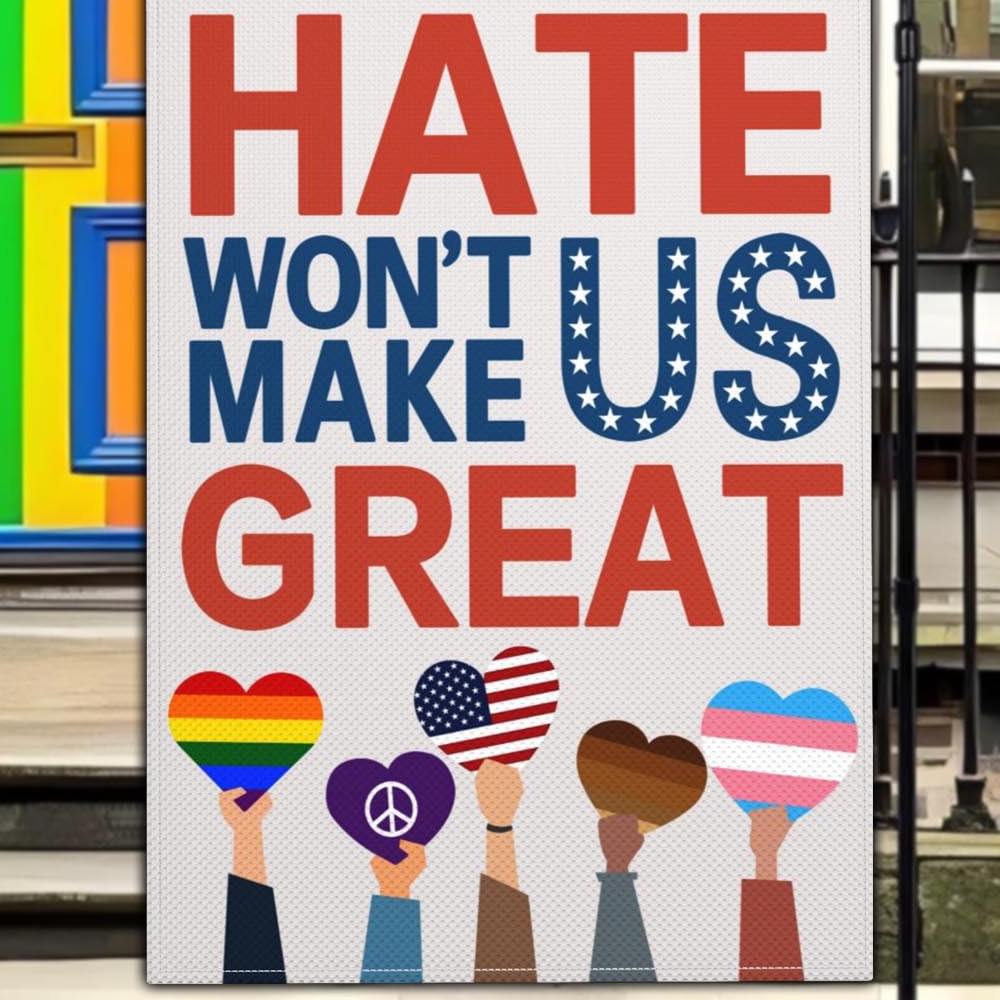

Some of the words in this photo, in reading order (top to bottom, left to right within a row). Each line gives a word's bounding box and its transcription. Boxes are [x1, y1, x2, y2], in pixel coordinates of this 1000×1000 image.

[190, 13, 831, 216] HATE
[183, 230, 532, 329] WON’T
[560, 233, 841, 442] US
[189, 339, 526, 443] MAKE
[182, 464, 844, 630] GREAT
